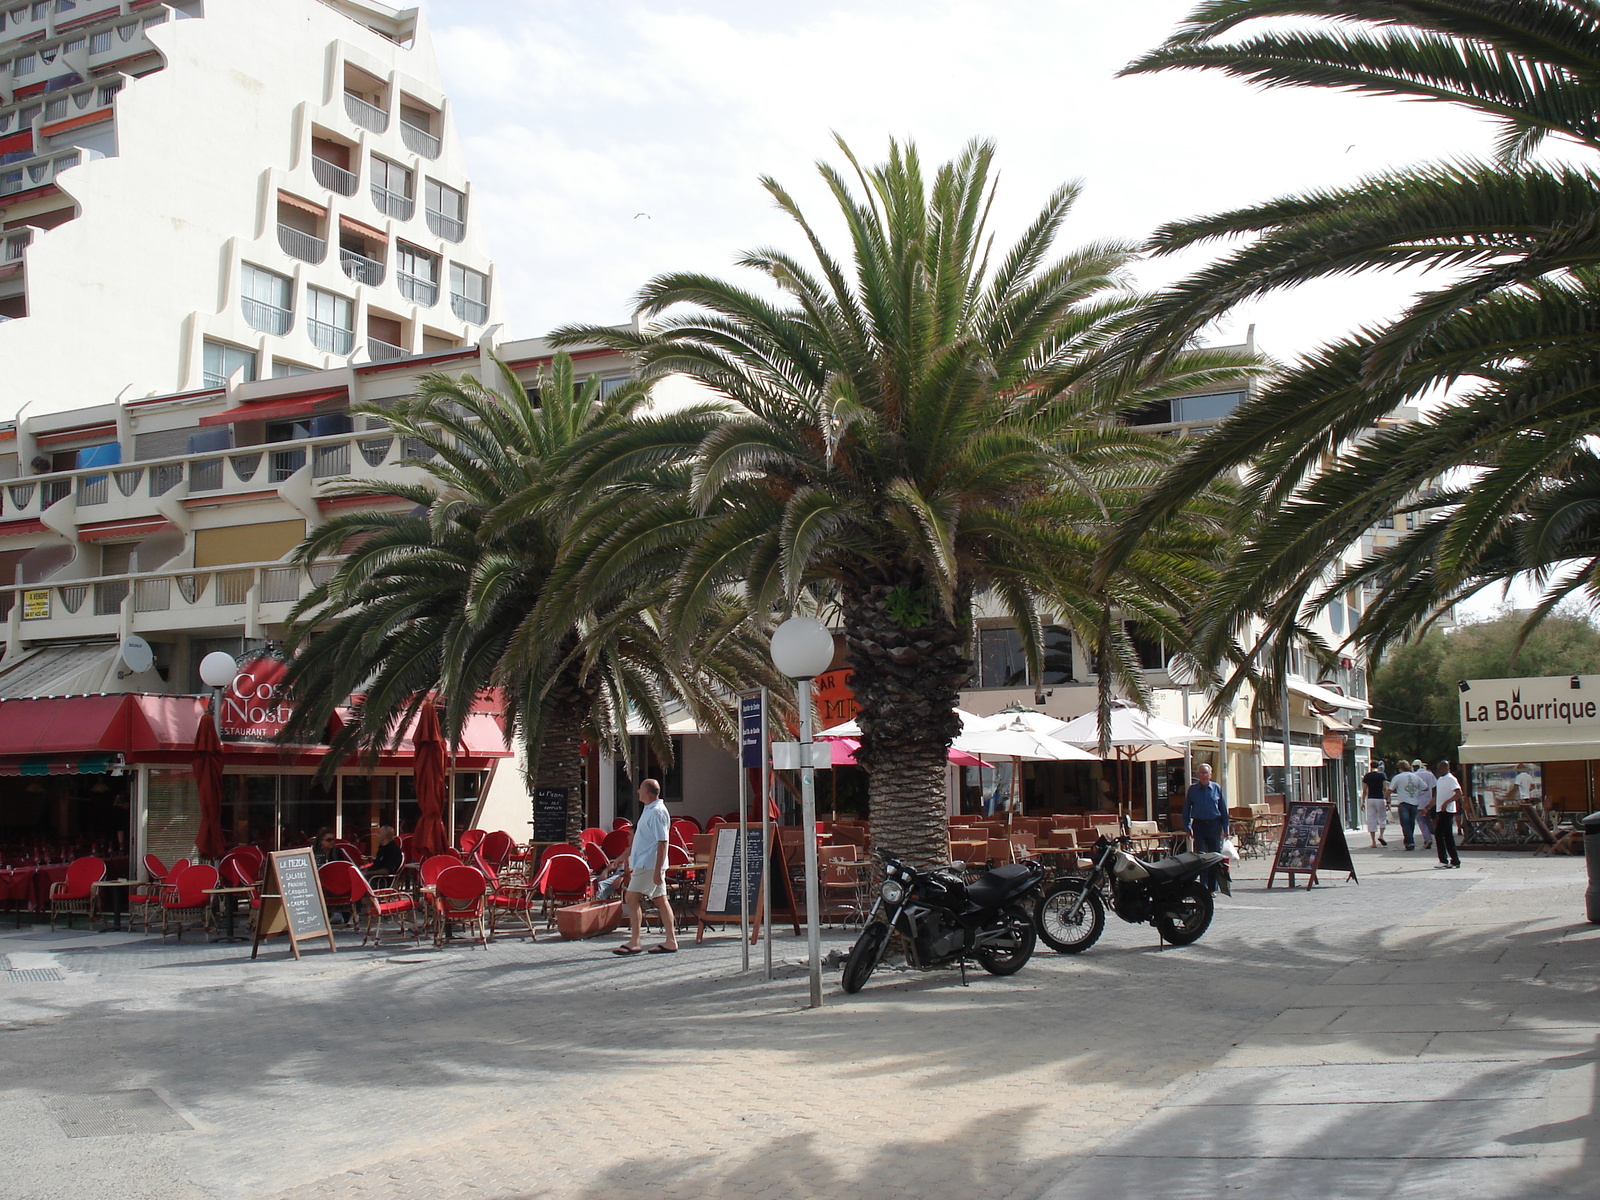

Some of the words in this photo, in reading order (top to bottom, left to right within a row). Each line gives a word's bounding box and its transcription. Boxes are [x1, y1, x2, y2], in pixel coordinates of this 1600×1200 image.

[33, 592, 48, 600] VENDRE
[820, 675, 835, 691] AR
[224, 697, 295, 724] Nostr
[1465, 701, 1489, 722] La
[1495, 697, 1597, 725] Bourrique
[220, 727, 267, 736] ESTAURANT
[288, 859, 308, 867] MEZCAL
[286, 872, 307, 881] SALADES
